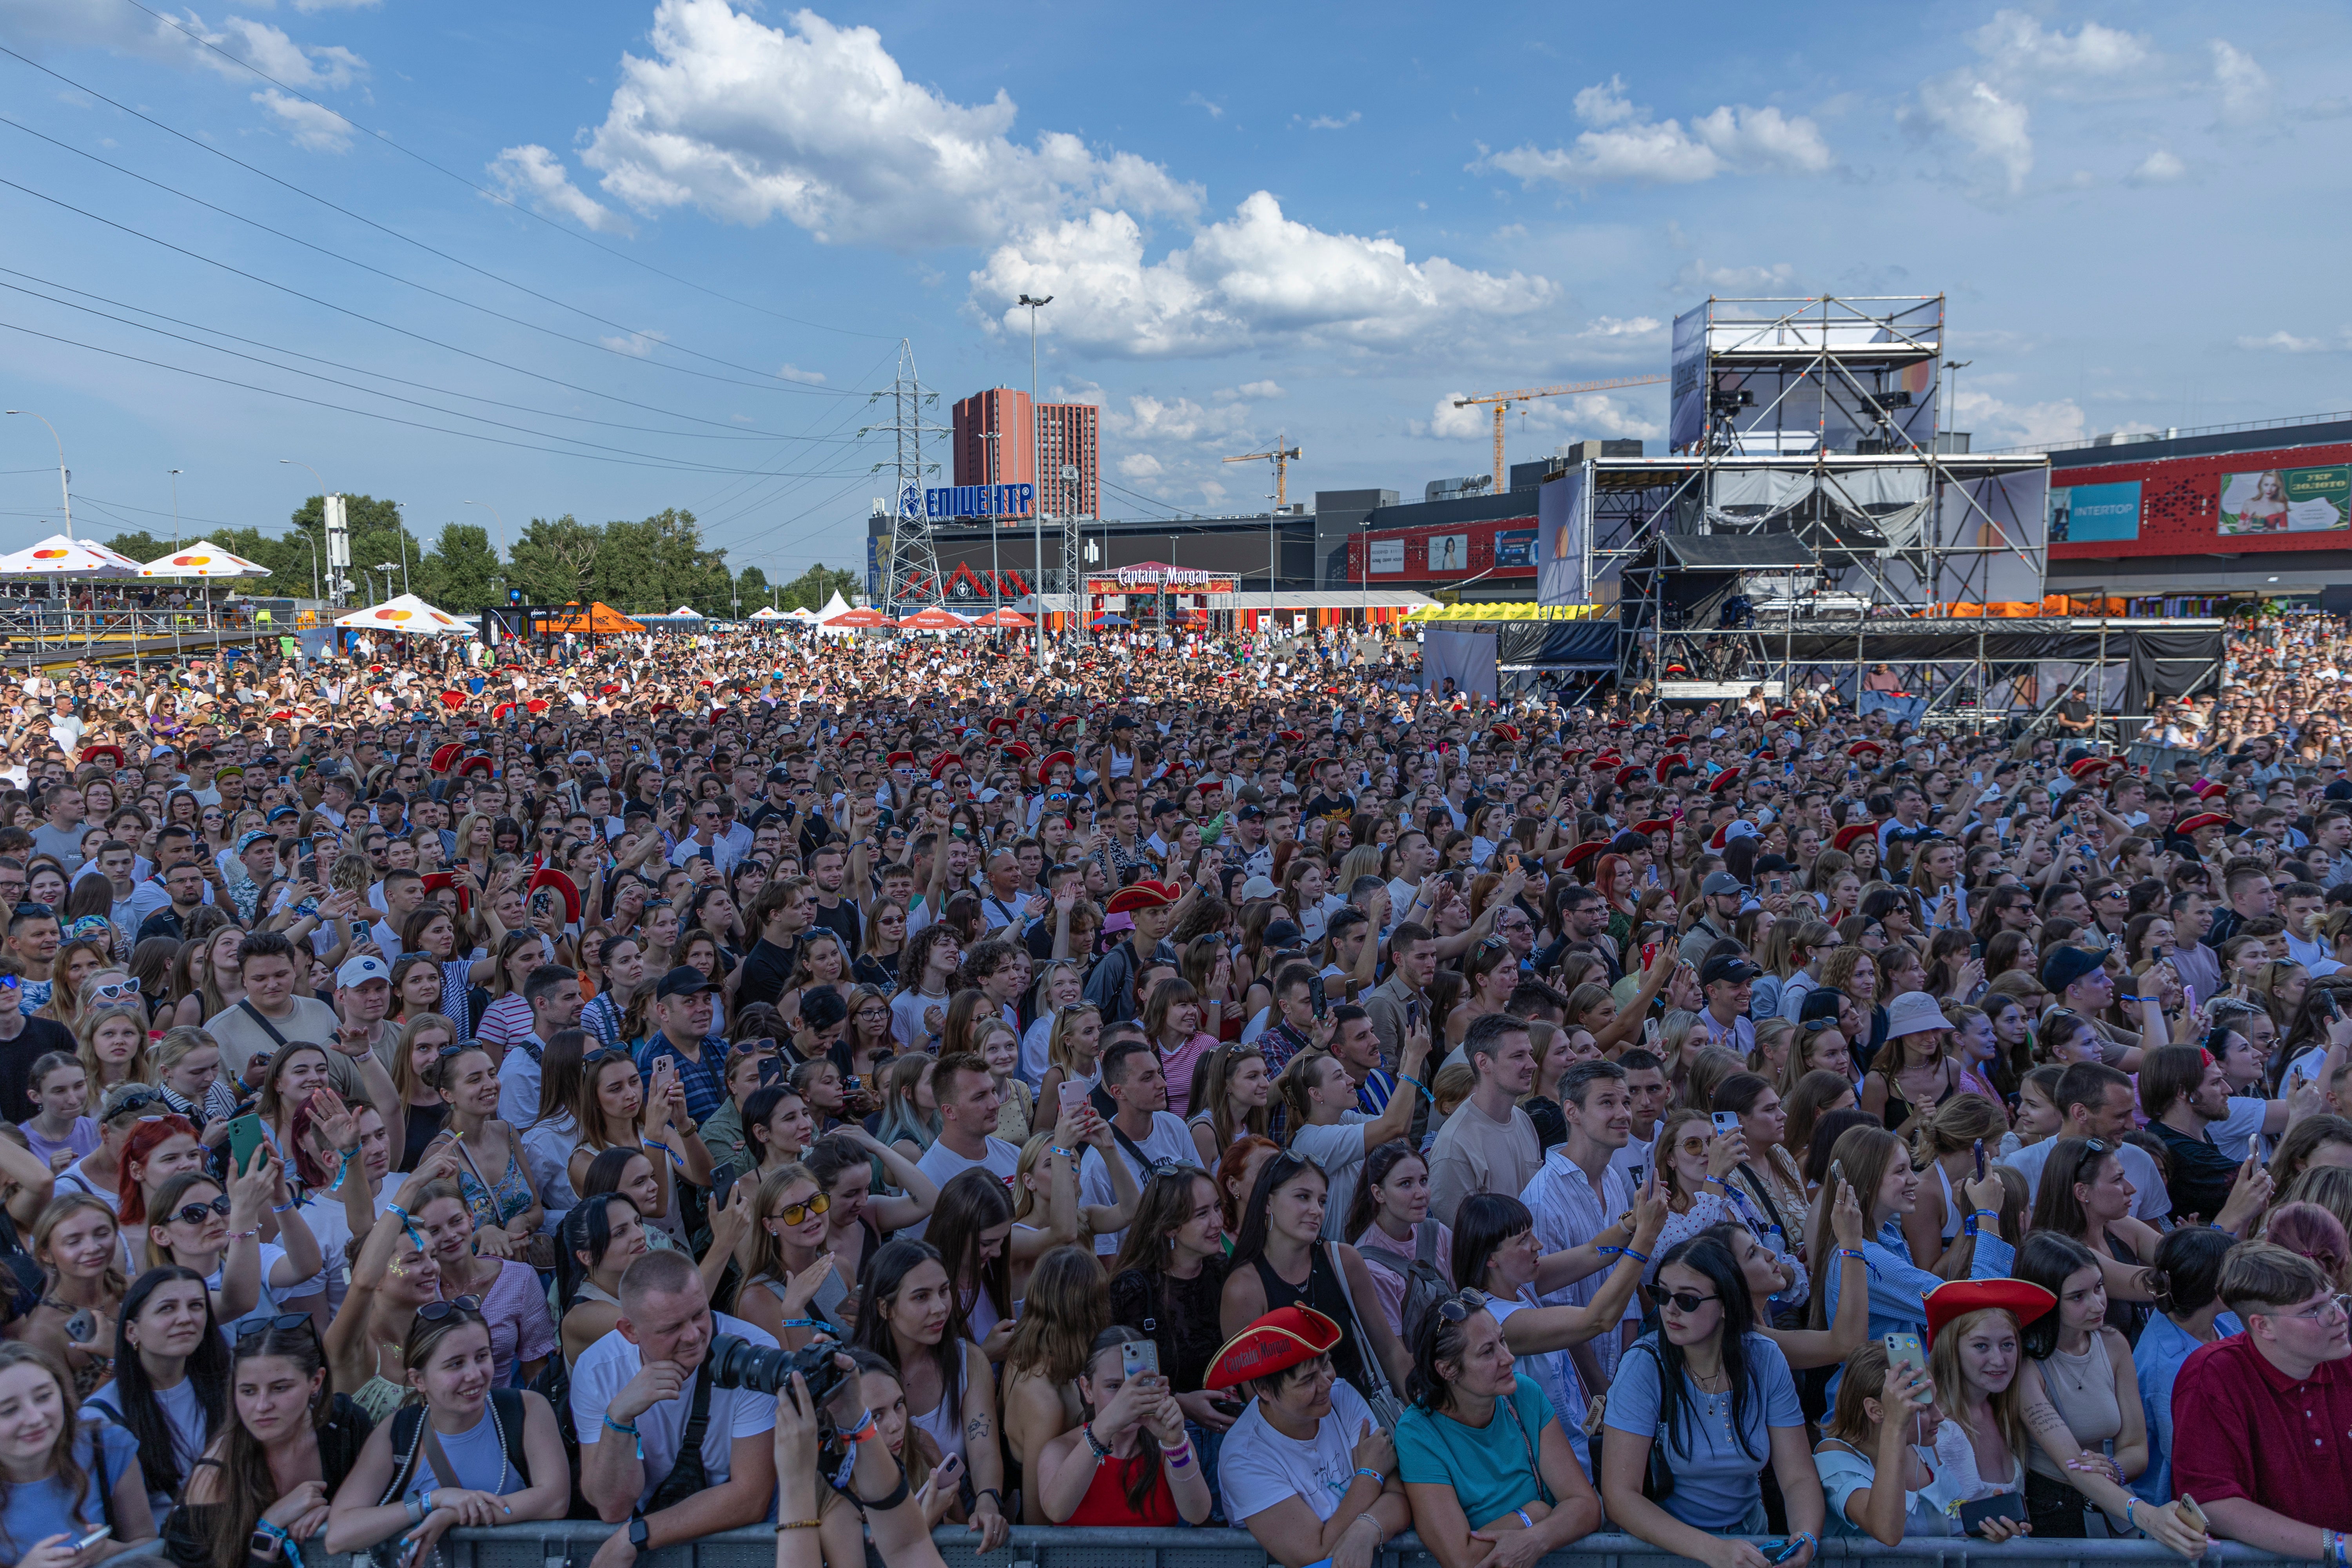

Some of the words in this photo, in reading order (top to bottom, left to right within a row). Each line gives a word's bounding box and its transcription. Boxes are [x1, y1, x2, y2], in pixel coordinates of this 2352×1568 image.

[2307, 473, 2333, 482] УКР
[2292, 480, 2346, 490] ЗОЛОТО
[926, 483, 1034, 518] ЕПІЦЕНТР
[2074, 503, 2133, 517] INTERTOP
[1118, 567, 1159, 587] Captain
[1163, 567, 1209, 587] Morgan
[531, 608, 546, 619] ploom
[1116, 898, 1134, 908] Captain
[1134, 896, 1153, 905] Morgan
[1223, 1347, 1259, 1375] Captain
[1258, 1338, 1292, 1365] Morgan
